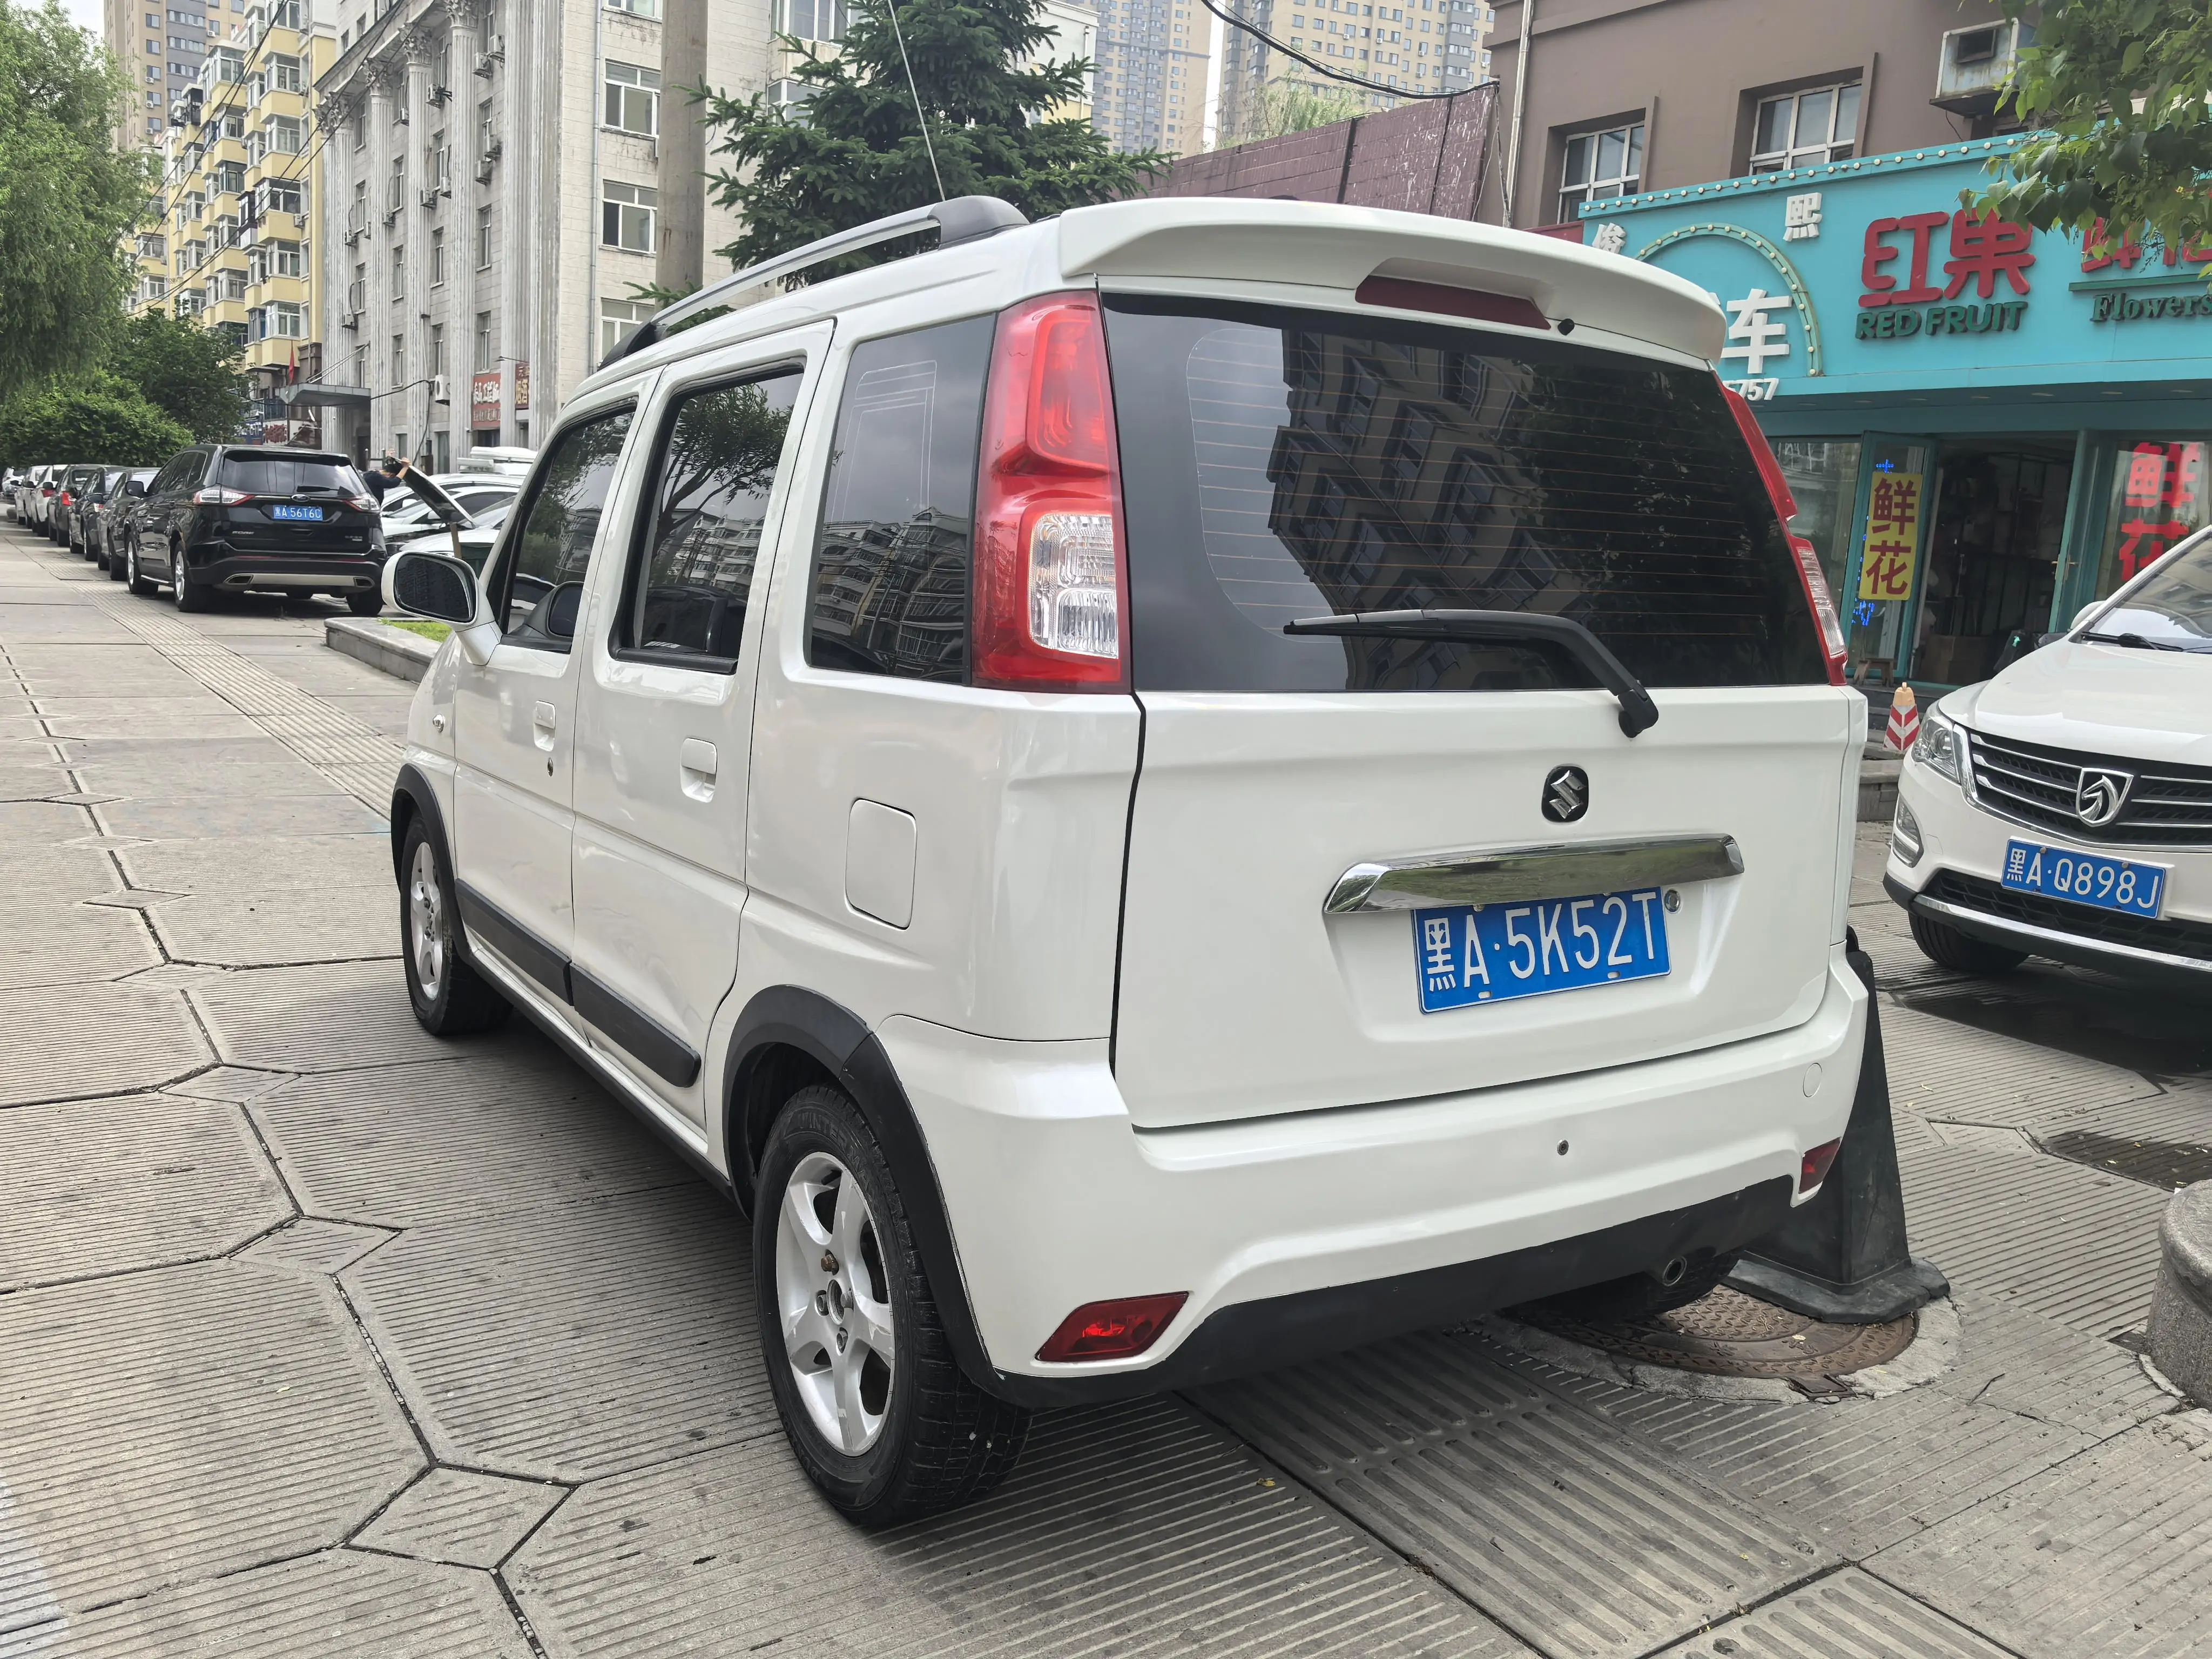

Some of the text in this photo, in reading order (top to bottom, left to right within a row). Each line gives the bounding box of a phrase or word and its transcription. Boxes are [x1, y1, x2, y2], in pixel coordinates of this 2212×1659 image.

[1783, 192, 1823, 242] 熙
[1858, 207, 2036, 308] 红果
[1709, 288, 1792, 374] 车
[1855, 301, 2029, 340] RED FRUIT
[2089, 292, 2212, 323] Flowers
[1865, 477, 1917, 595] 鲜花
[2118, 442, 2201, 582] 鲜花
[2006, 848, 2159, 909] 黑A·Q898J
[1424, 892, 1657, 992] 黑A·5K52T
